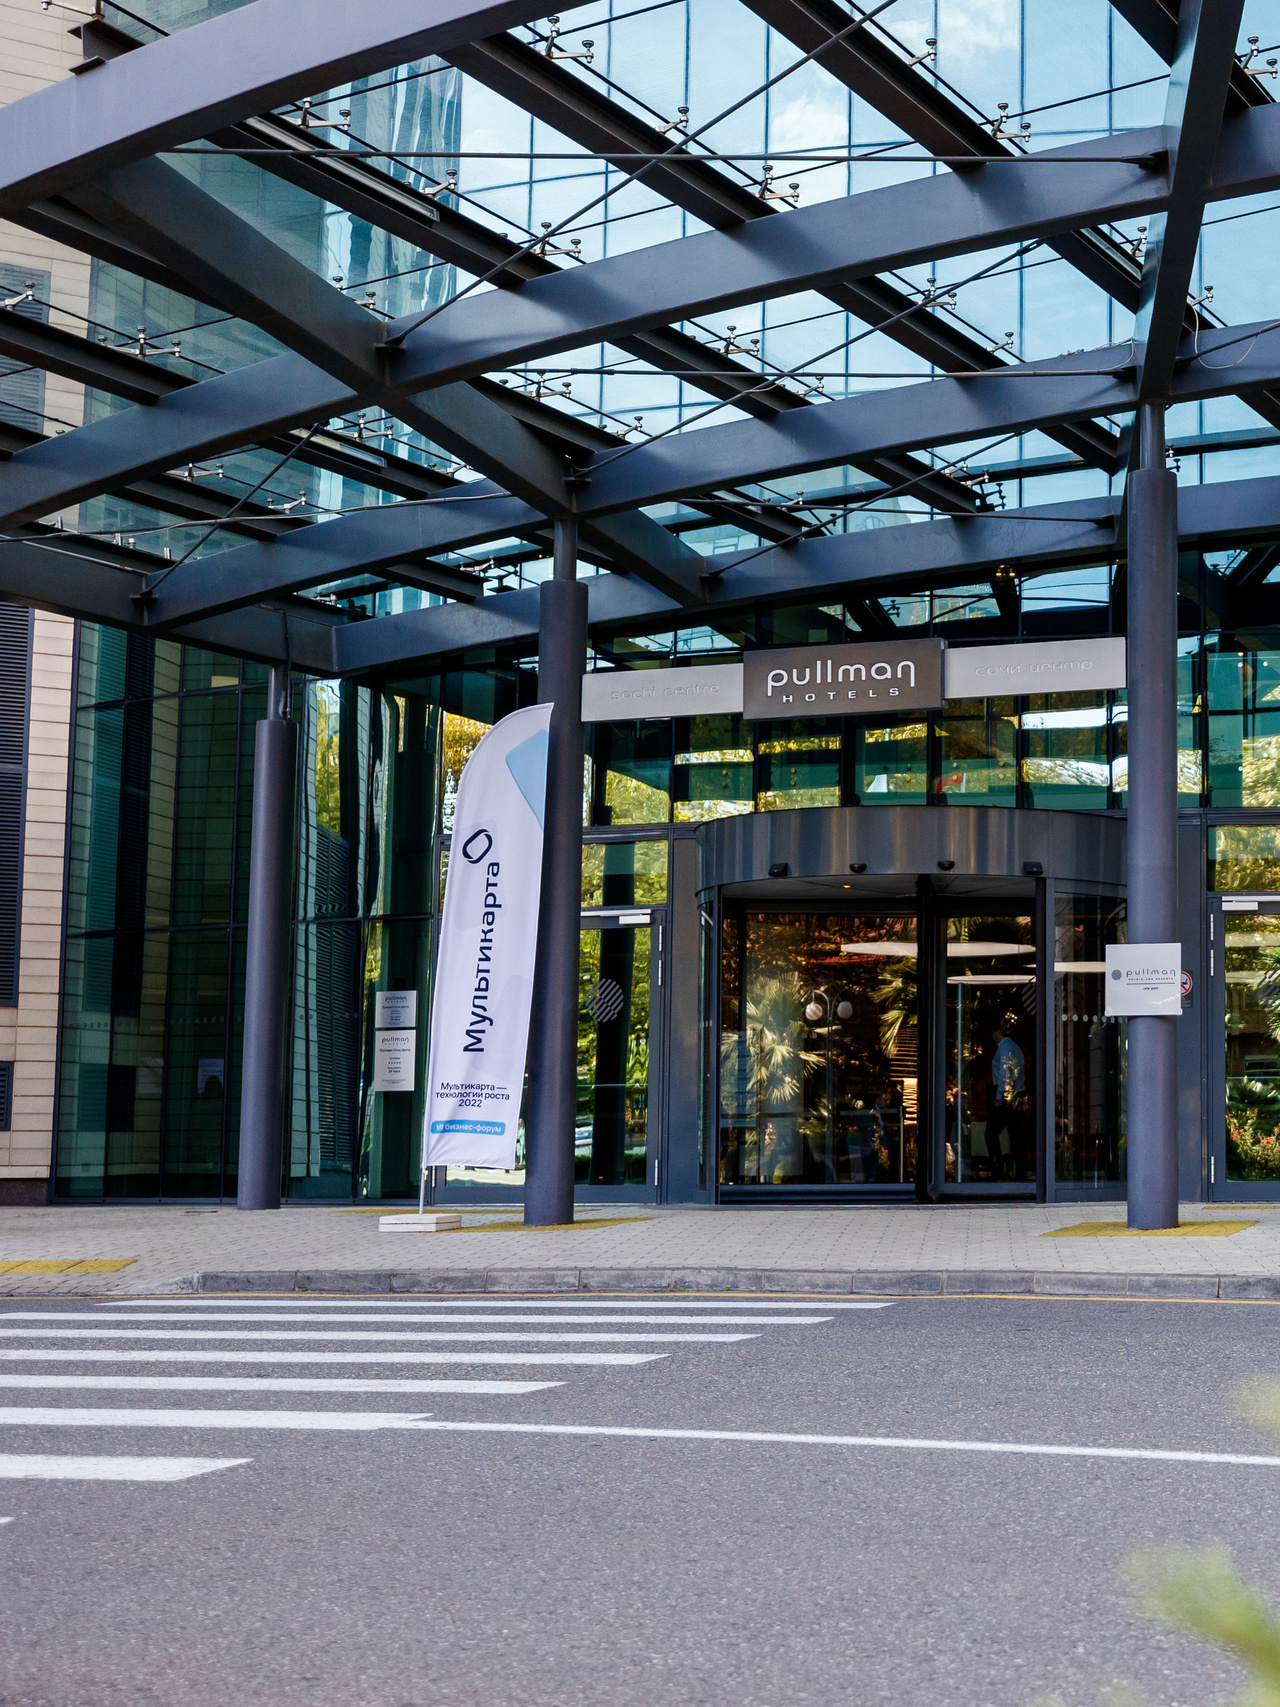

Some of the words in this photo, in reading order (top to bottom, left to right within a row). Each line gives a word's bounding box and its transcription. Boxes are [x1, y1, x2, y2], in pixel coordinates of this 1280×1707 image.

[975, 664, 1021, 676] сочи
[1028, 659, 1093, 673] центр
[767, 659, 916, 697] pullman
[610, 685, 656, 700] sochi
[662, 683, 720, 697] centre
[782, 687, 900, 703] HOTELS
[462, 861, 503, 1053] Мультикарта
[1126, 968, 1176, 978] pullman
[381, 1036, 410, 1044] pullman
[458, 1098, 483, 1107] 2022
[484, 1092, 510, 1101] роста
[444, 1123, 502, 1133] бизнес-форум
